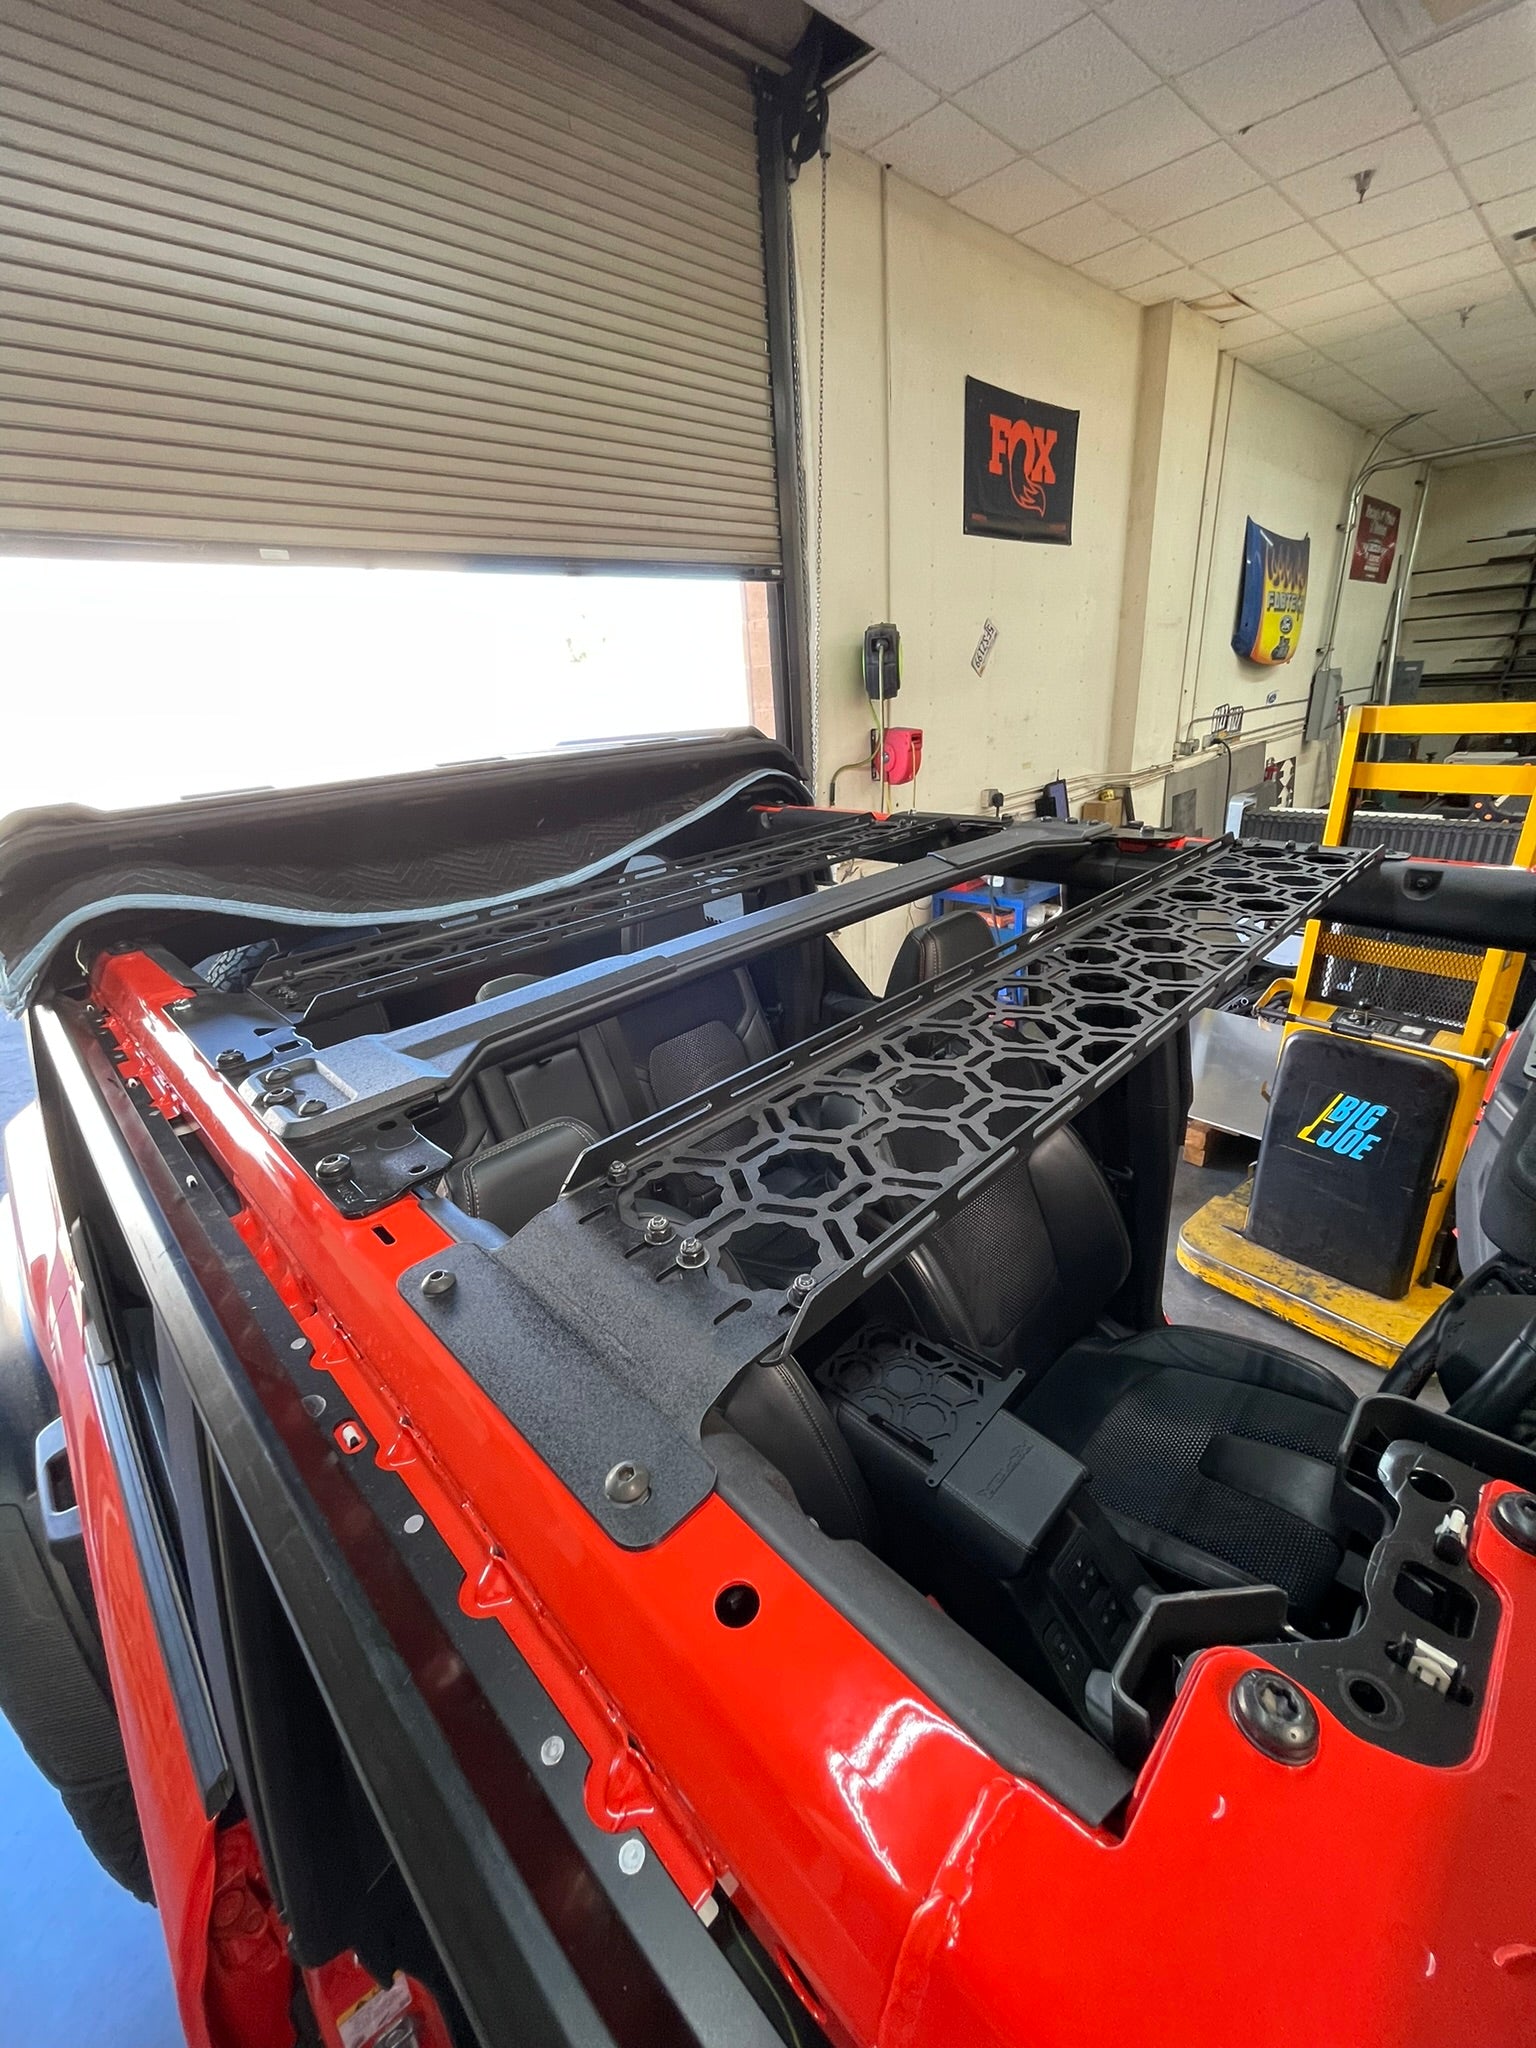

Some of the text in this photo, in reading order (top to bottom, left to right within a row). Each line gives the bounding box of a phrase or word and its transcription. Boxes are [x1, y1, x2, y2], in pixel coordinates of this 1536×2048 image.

[988, 413, 1058, 485] FOX
[1328, 1095, 1388, 1131] BIG
[1316, 1128, 1382, 1160] JOE
